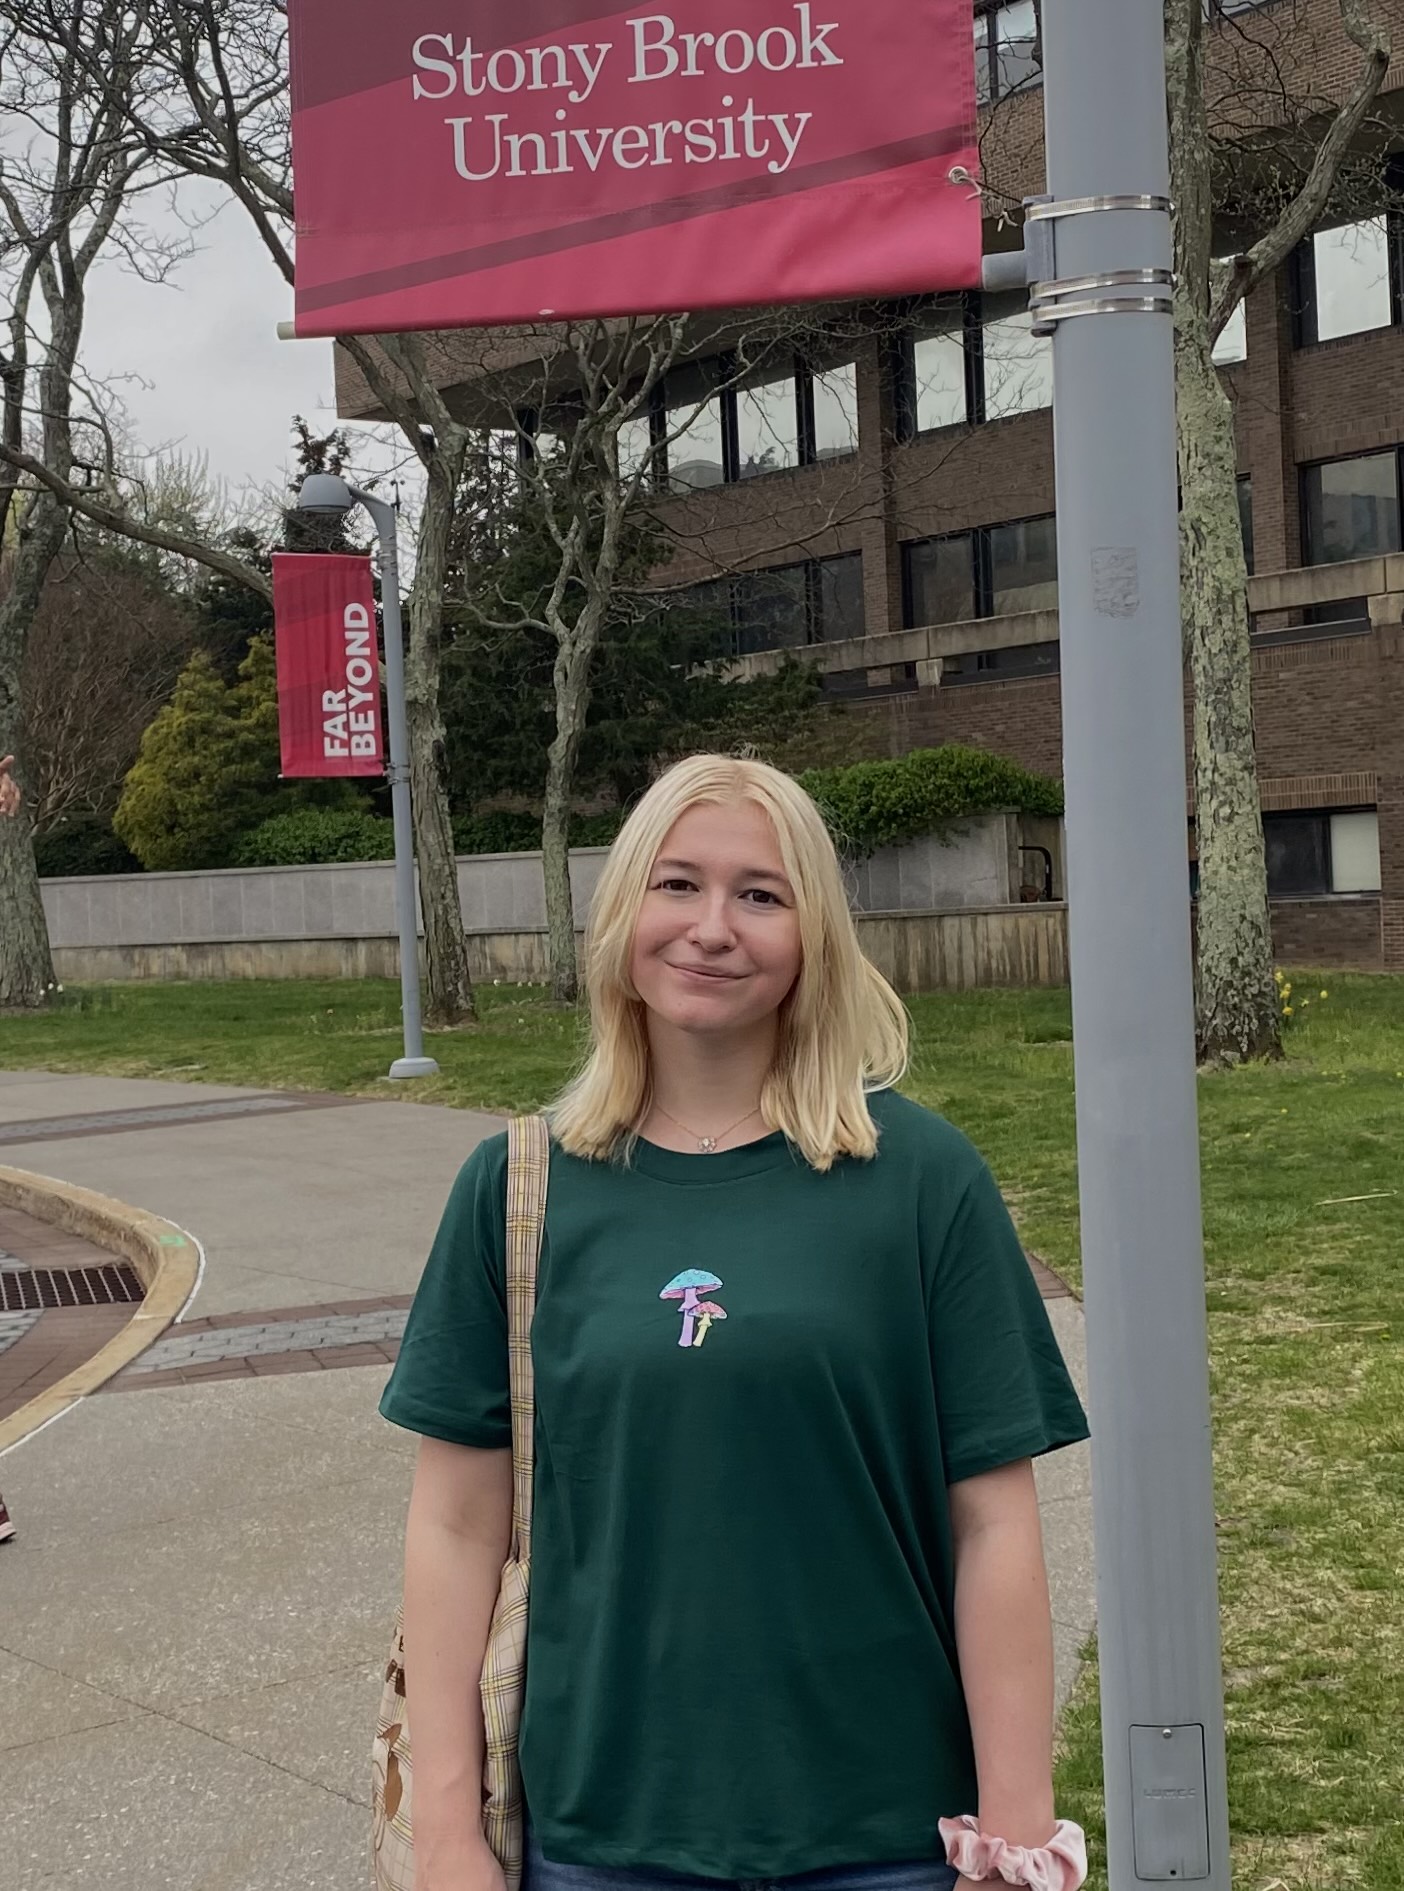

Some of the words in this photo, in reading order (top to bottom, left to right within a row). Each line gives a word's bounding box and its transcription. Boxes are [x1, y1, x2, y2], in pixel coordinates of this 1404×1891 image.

[411, 33, 613, 104] Stony
[625, 2, 844, 83] Brook
[444, 95, 813, 182] University
[322, 688, 349, 758] FAR
[343, 602, 377, 757] BEYOND
